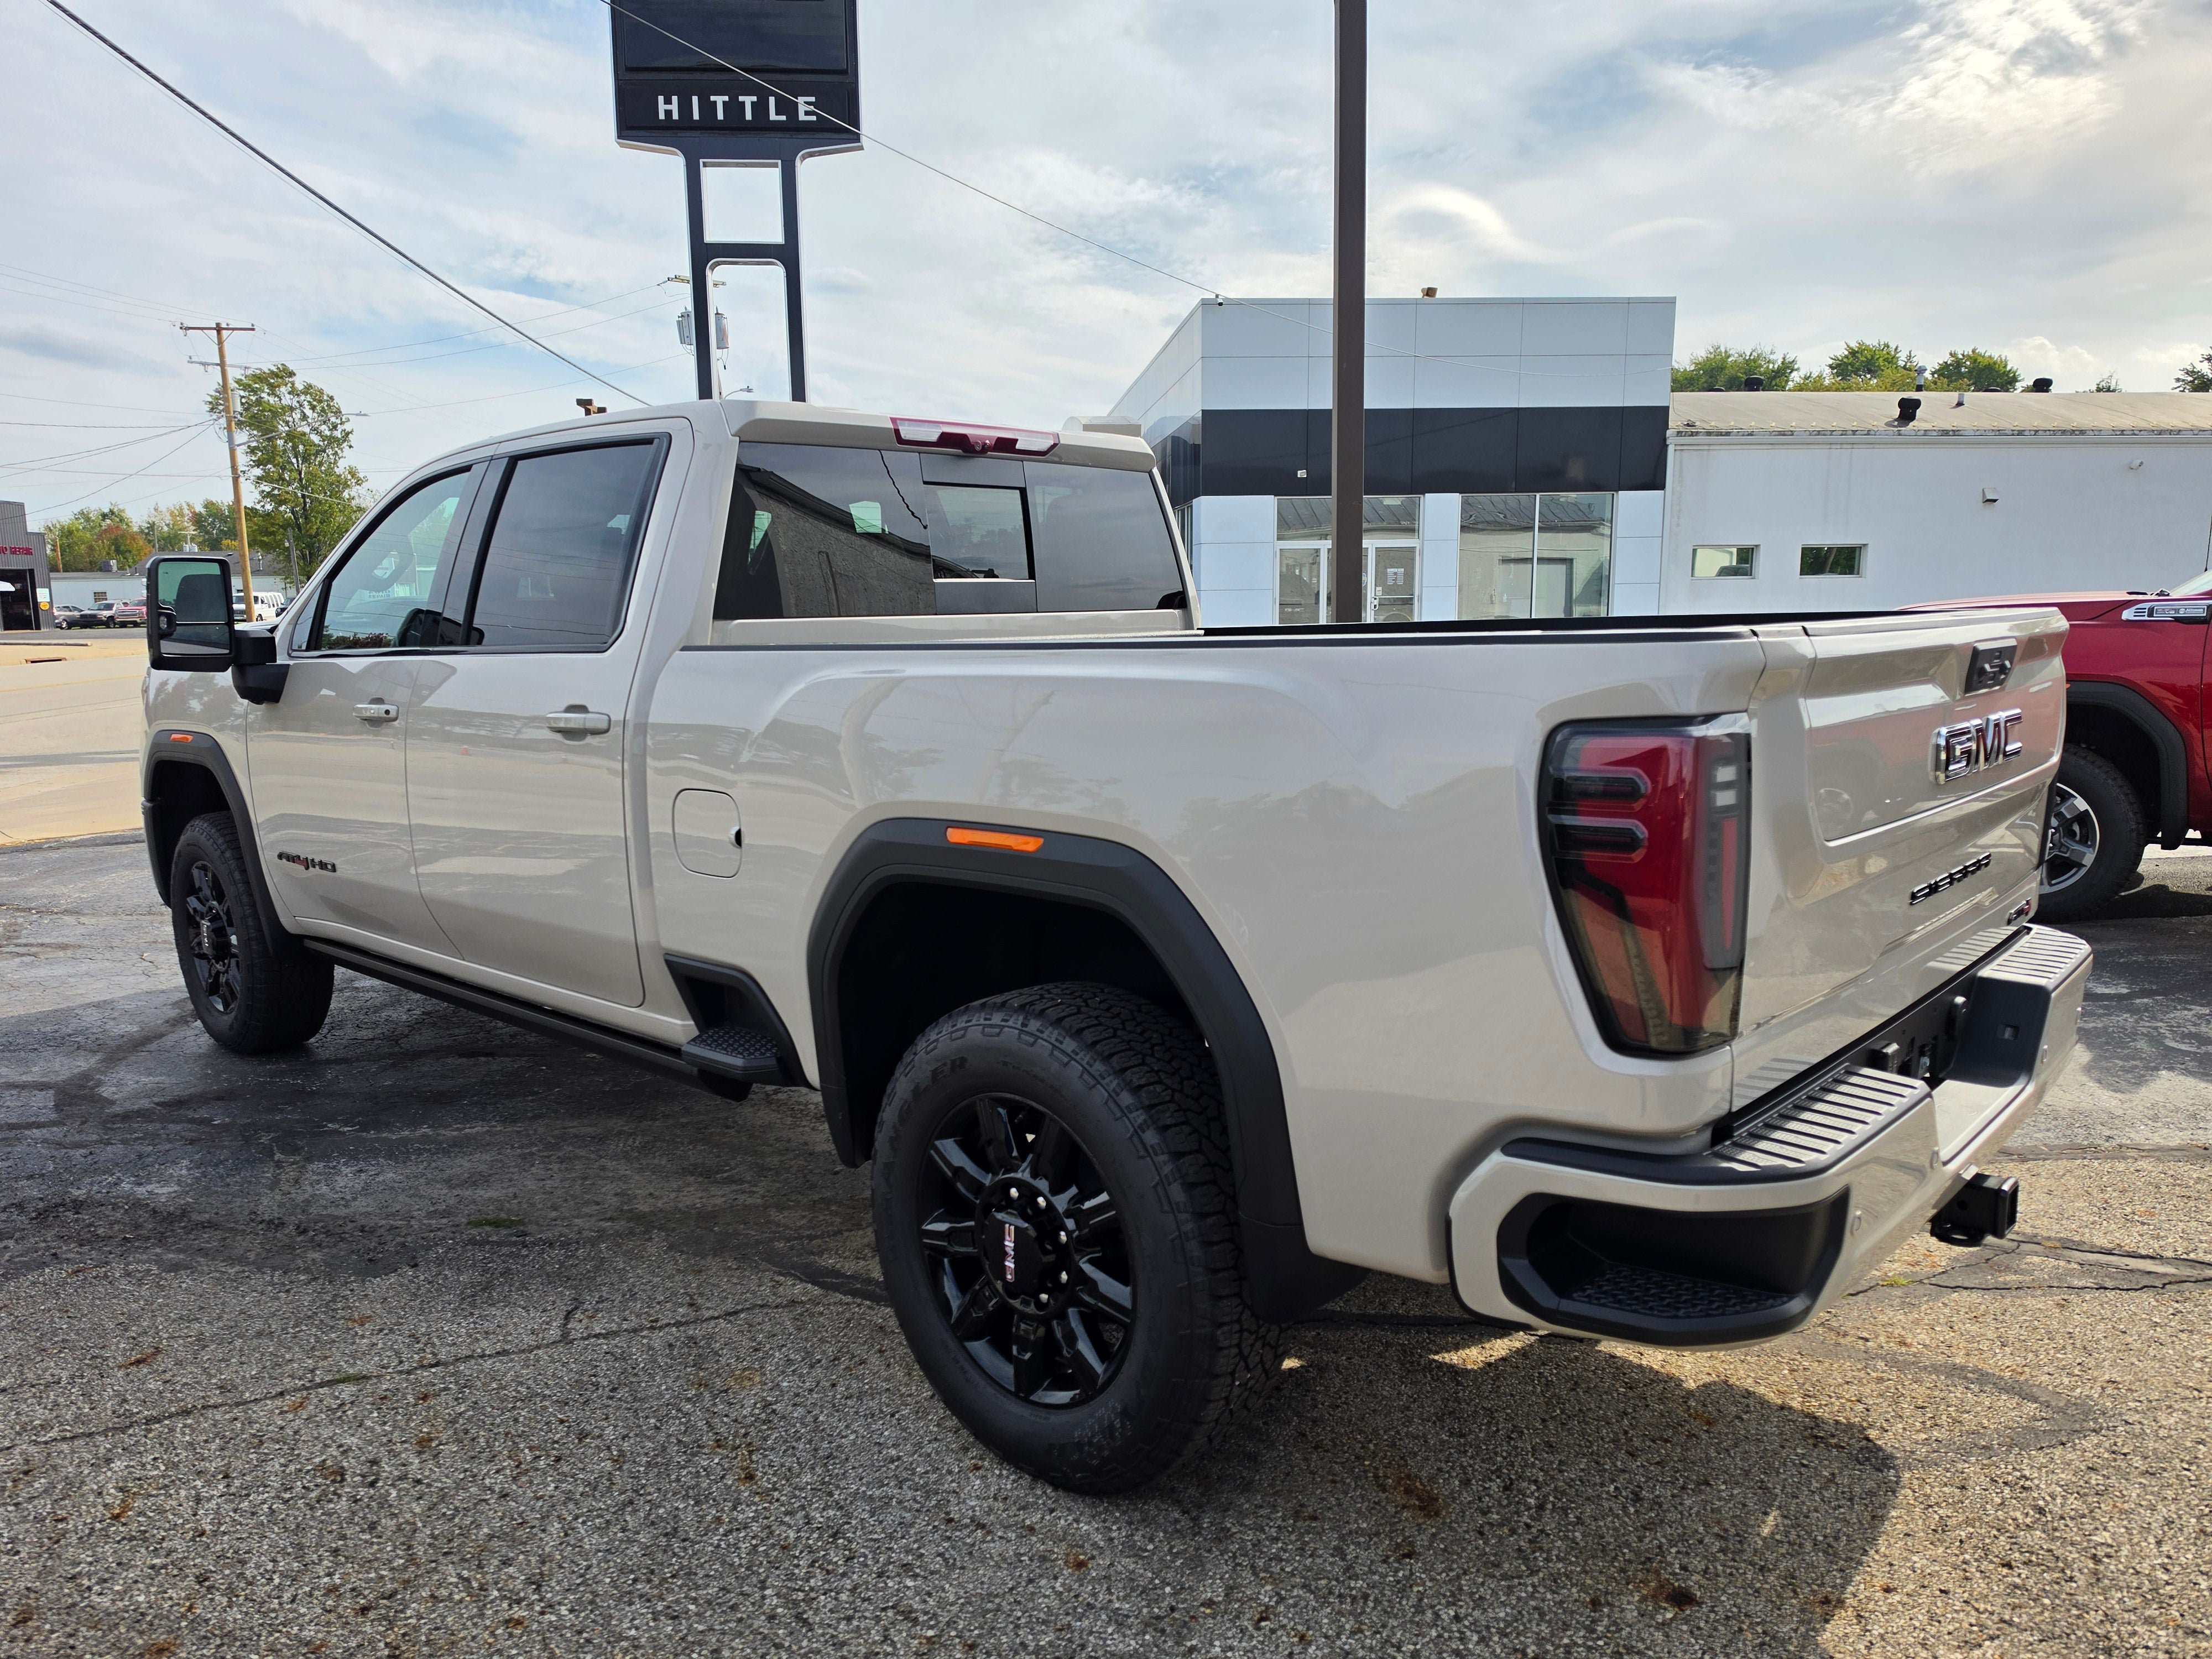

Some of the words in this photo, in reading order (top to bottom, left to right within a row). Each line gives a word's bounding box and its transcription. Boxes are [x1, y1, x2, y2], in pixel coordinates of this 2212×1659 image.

[658, 95, 817, 121] HITTLE
[10, 546, 33, 555] REPAIR
[1928, 708, 2023, 785] GMC
[1909, 852, 1991, 905] SIERRA
[1004, 1223, 1015, 1282] GMC
